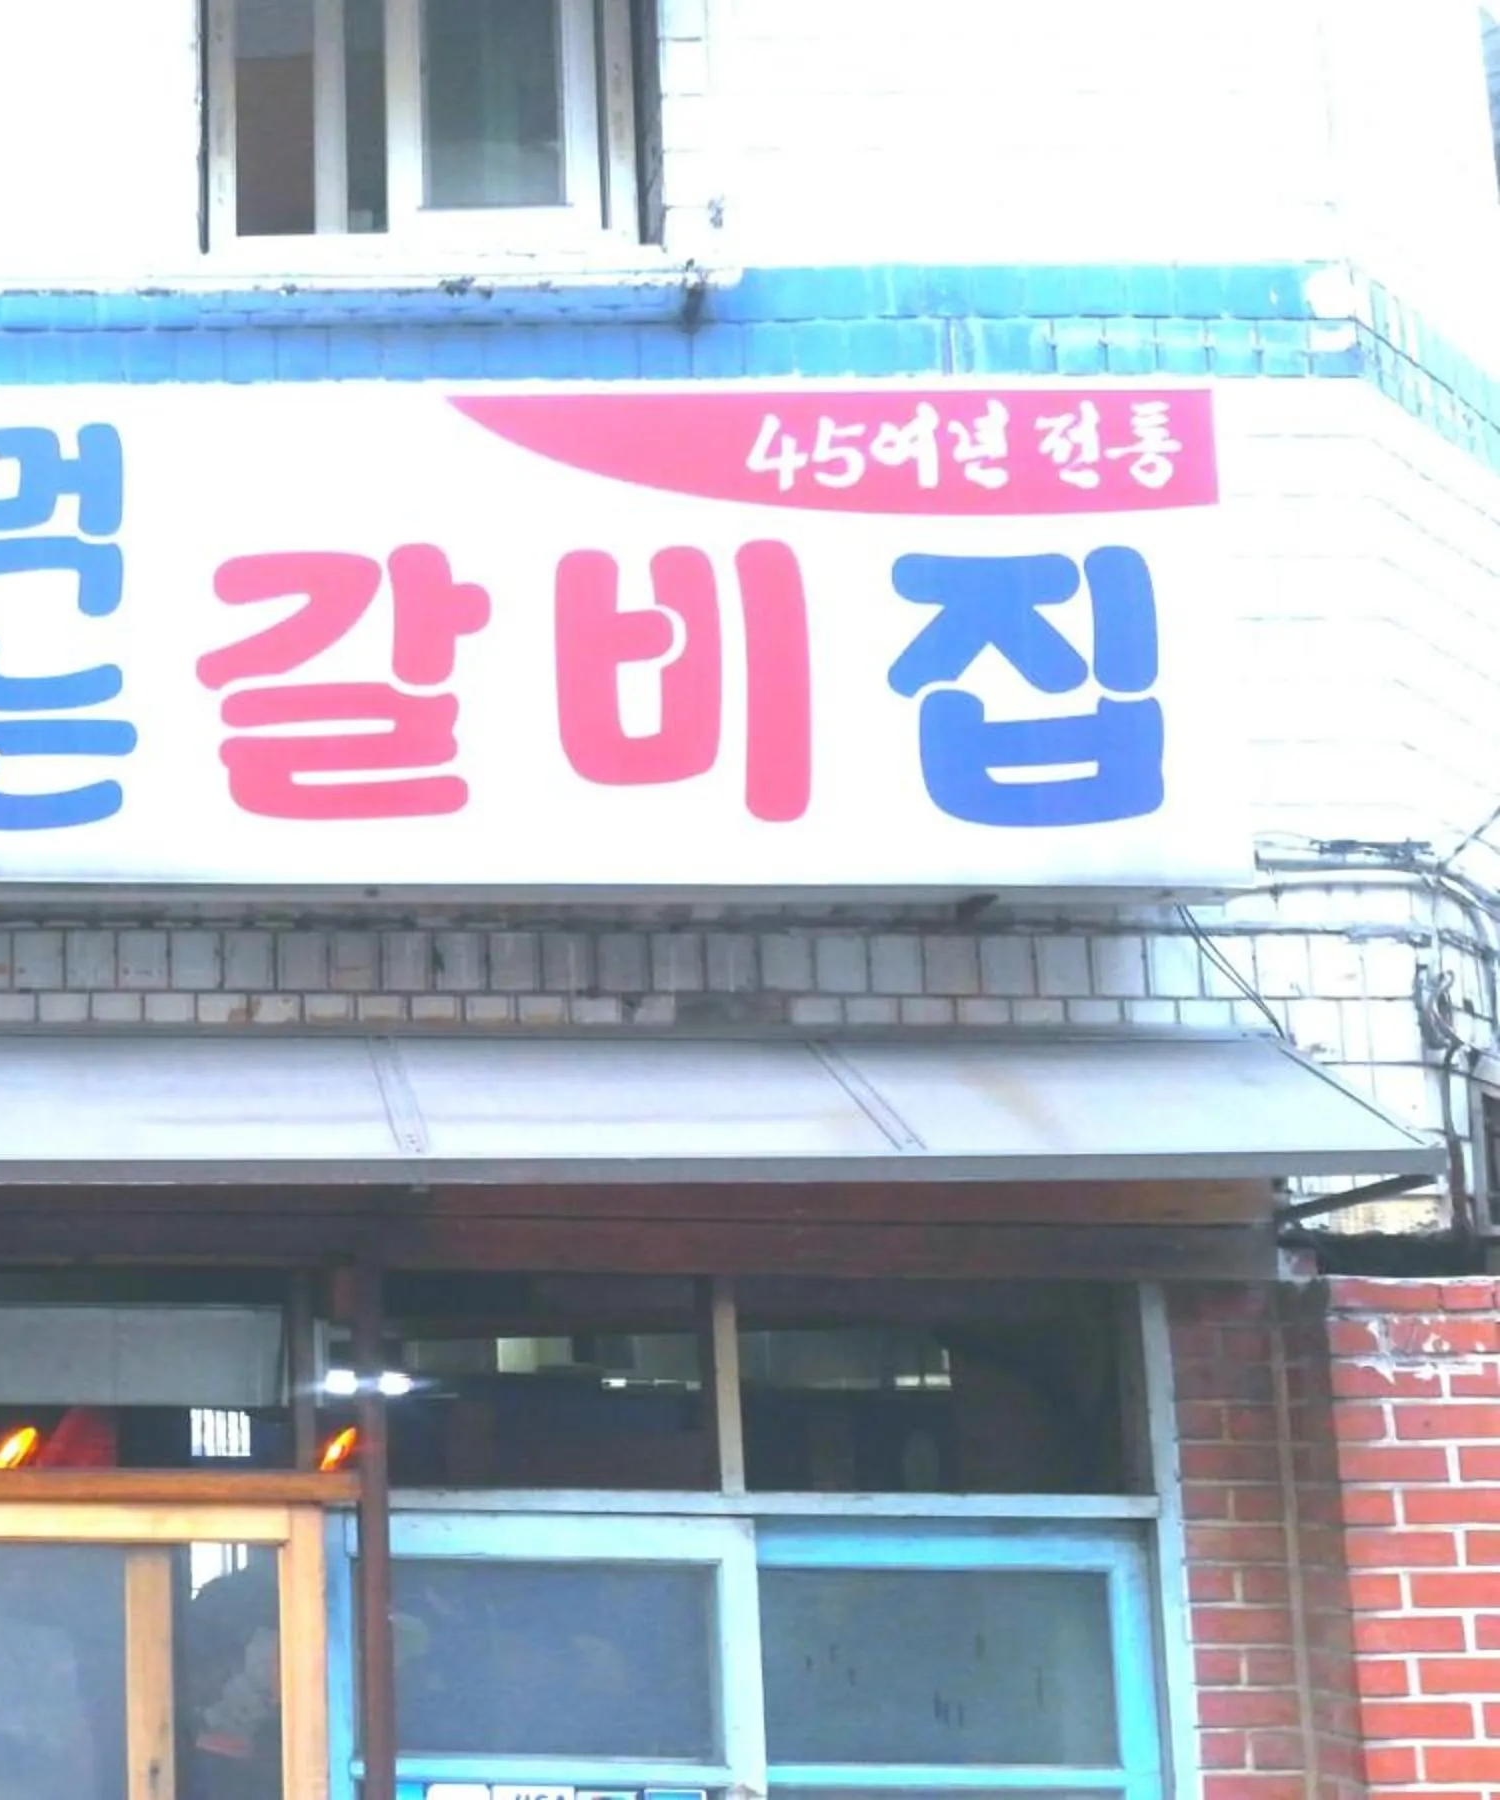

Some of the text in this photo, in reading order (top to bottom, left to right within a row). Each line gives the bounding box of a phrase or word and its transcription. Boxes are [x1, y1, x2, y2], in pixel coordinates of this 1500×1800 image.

[746, 398, 1183, 491] 45여년 전통
[196, 539, 1165, 828] 갈비집
